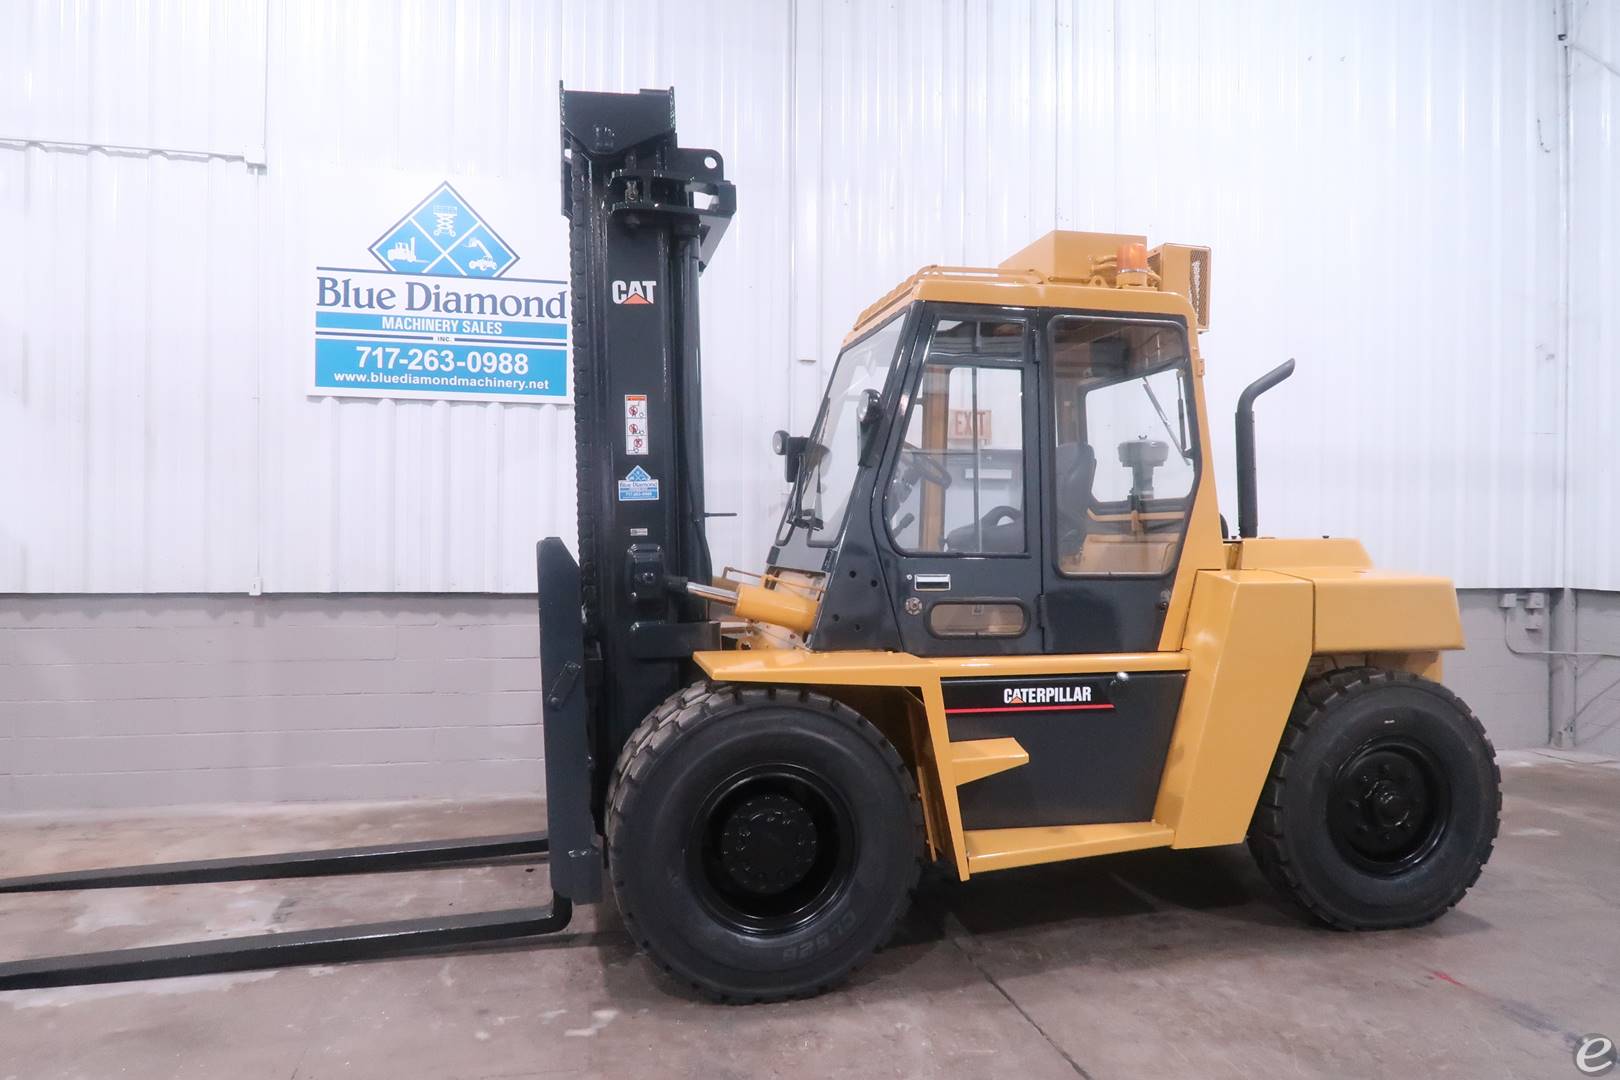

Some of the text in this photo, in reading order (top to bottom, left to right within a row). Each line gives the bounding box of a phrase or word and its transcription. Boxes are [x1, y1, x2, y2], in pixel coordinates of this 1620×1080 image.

[316, 276, 567, 319] Blue Diamond
[612, 280, 657, 304] CAT
[382, 316, 503, 335] MACHINERY SALES
[355, 345, 529, 376] 717-263-0988
[333, 371, 549, 391] www.bluediamondmachinery.net
[955, 411, 986, 436] EXT
[1003, 686, 1092, 704] CATERPILLAR
